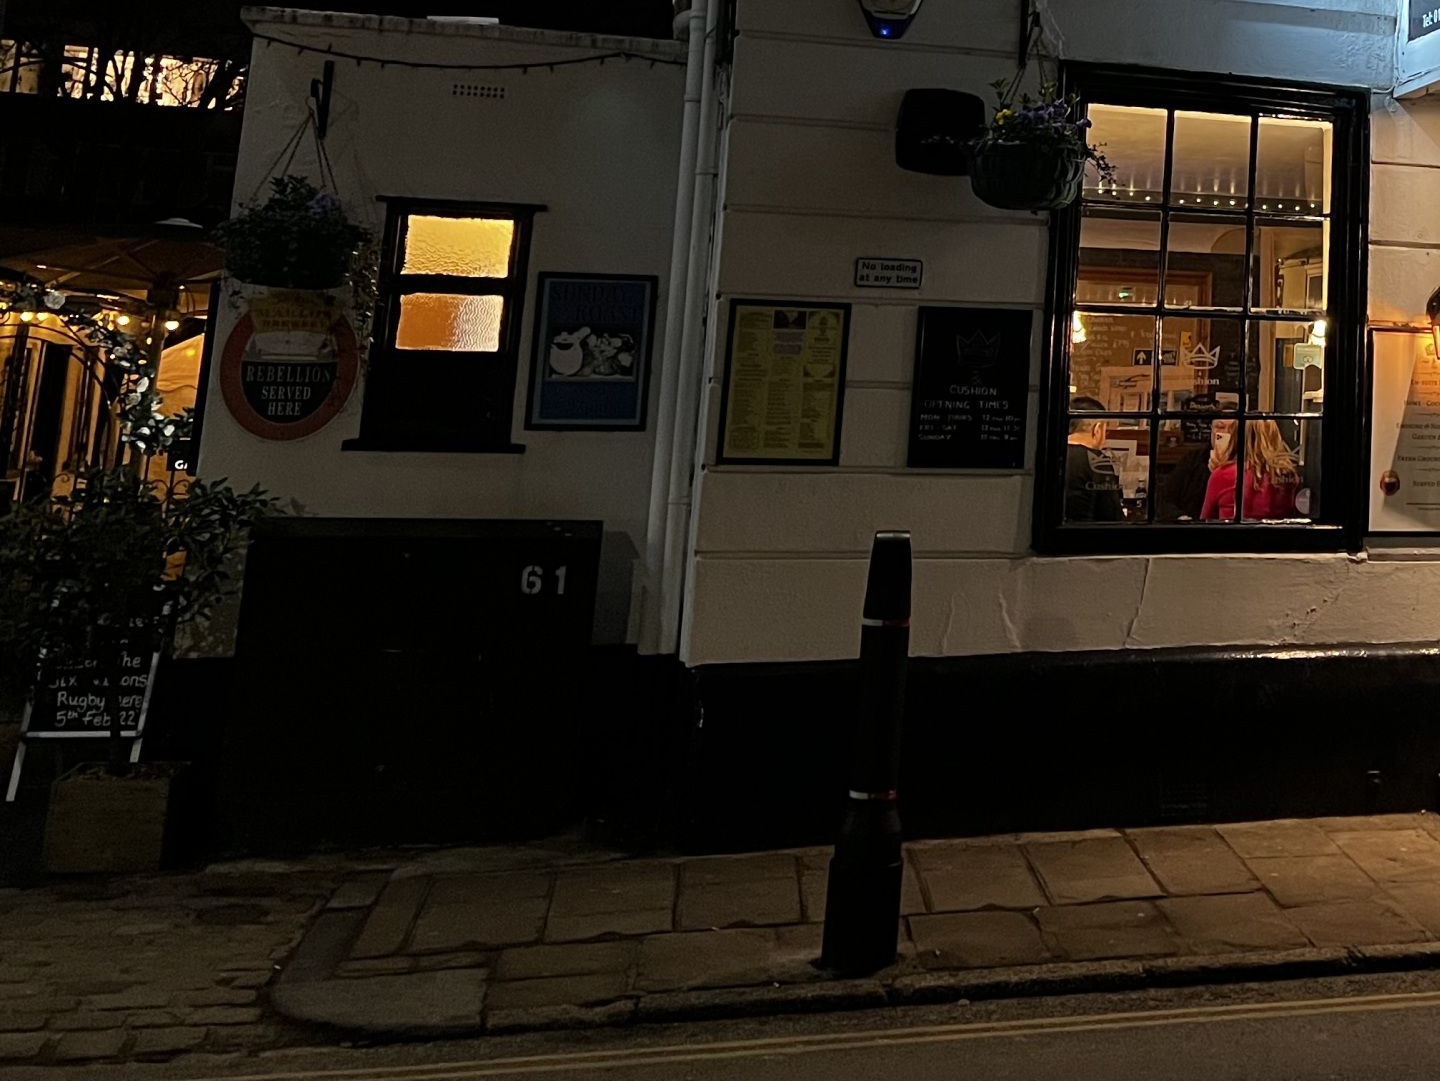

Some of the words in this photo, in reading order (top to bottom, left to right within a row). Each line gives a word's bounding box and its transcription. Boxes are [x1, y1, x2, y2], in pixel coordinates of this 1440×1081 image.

[862, 261, 877, 270] No
[881, 263, 917, 273] loading
[859, 274, 870, 282] at
[874, 275, 892, 285] any
[896, 275, 918, 283] time
[246, 365, 331, 383] REBELLION
[260, 385, 312, 400] SERVED
[949, 384, 997, 396] CUSHION
[267, 401, 303, 416] HERE
[520, 564, 567, 595] 61
[57, 691, 105, 712] Rugby
[82, 710, 112, 726] Feb
